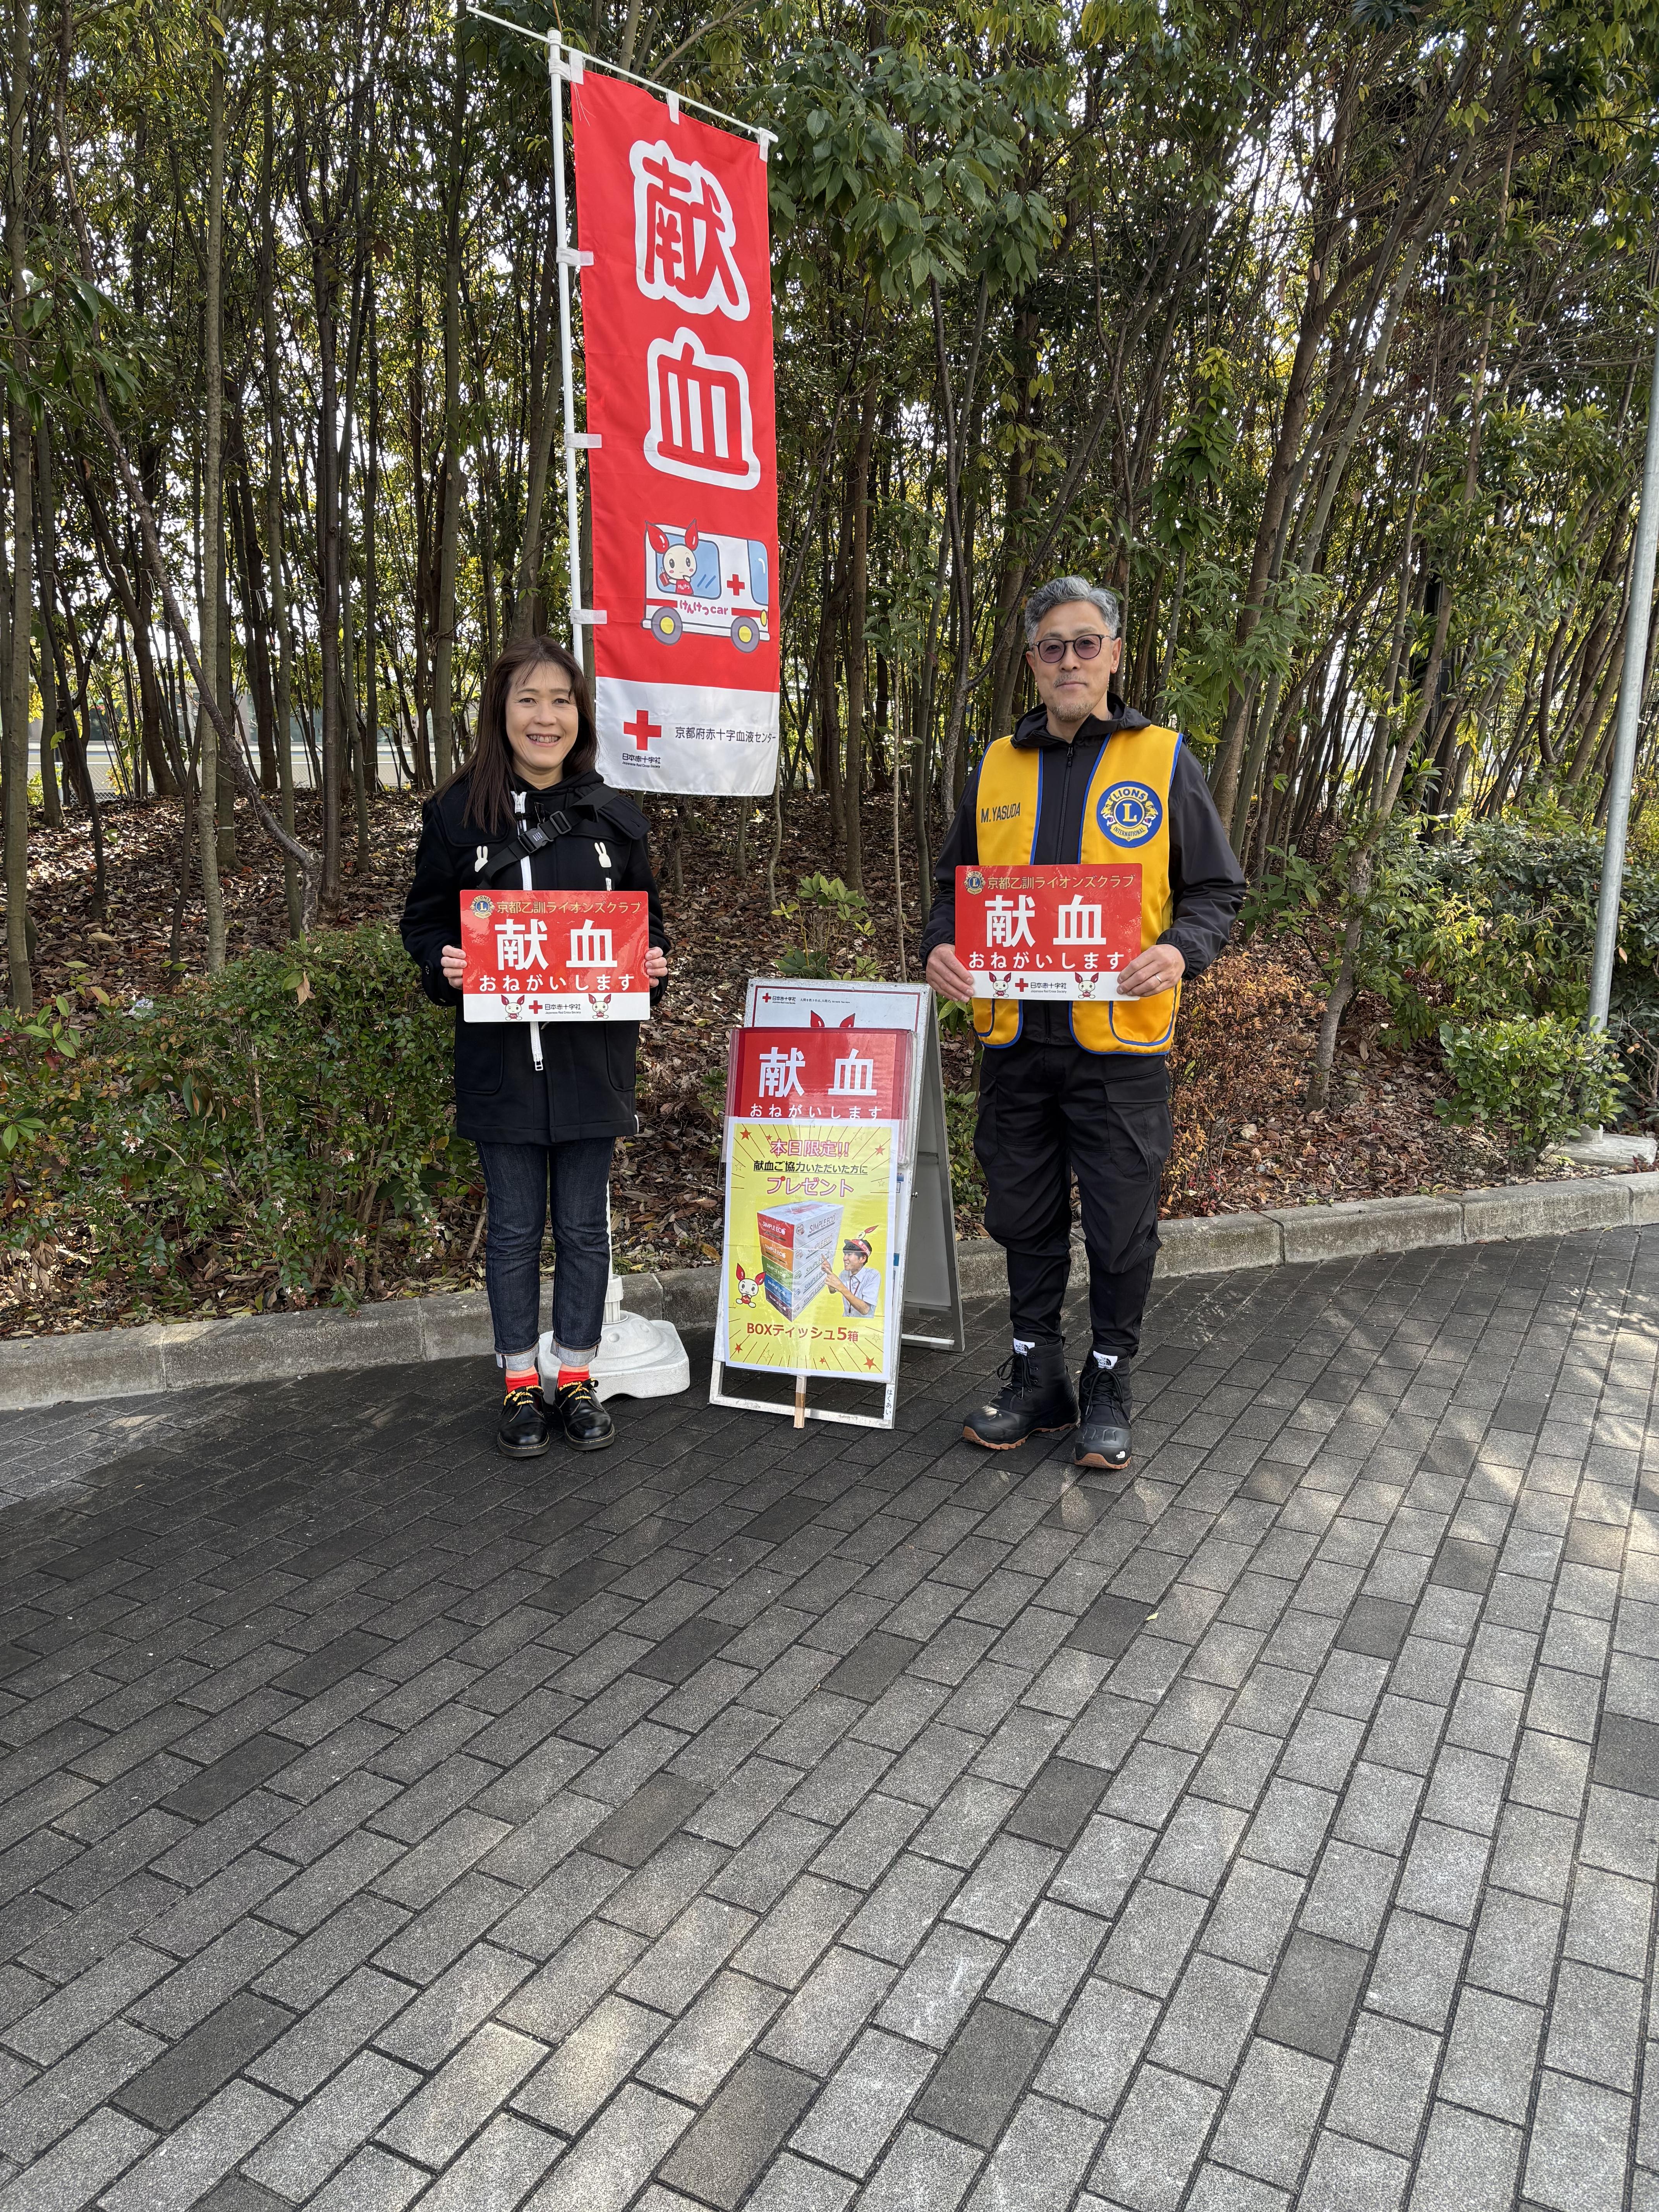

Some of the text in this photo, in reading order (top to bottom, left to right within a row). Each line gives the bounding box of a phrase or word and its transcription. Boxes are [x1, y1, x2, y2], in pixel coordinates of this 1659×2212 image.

[630, 140, 760, 490] 献血
[675, 726, 776, 744] 京都府赤十字血液センター
[622, 753, 661, 764] 日本赤十字社
[1113, 788, 1146, 800] LIONS
[1123, 804, 1137, 822] L
[1113, 826, 1146, 837] INTERNATIONAL
[987, 874, 1136, 890] 京都乙訓ライオンズクラブ
[496, 901, 642, 914] 京都乙訓ライオンズクラブ
[984, 894, 1107, 948] 献血
[495, 919, 618, 971] 献血
[969, 951, 1124, 970] おねがいします
[479, 974, 635, 992] おねがいします
[758, 1047, 877, 1097] 献血
[750, 1103, 882, 1120] おねがいします
[770, 1139, 850, 1157] 本日限定!!
[754, 1160, 868, 1174] 献血ご協力いただいた方に
[767, 1176, 854, 1197] プレゼント
[747, 1322, 859, 1342] BOXティッシュ5箱
